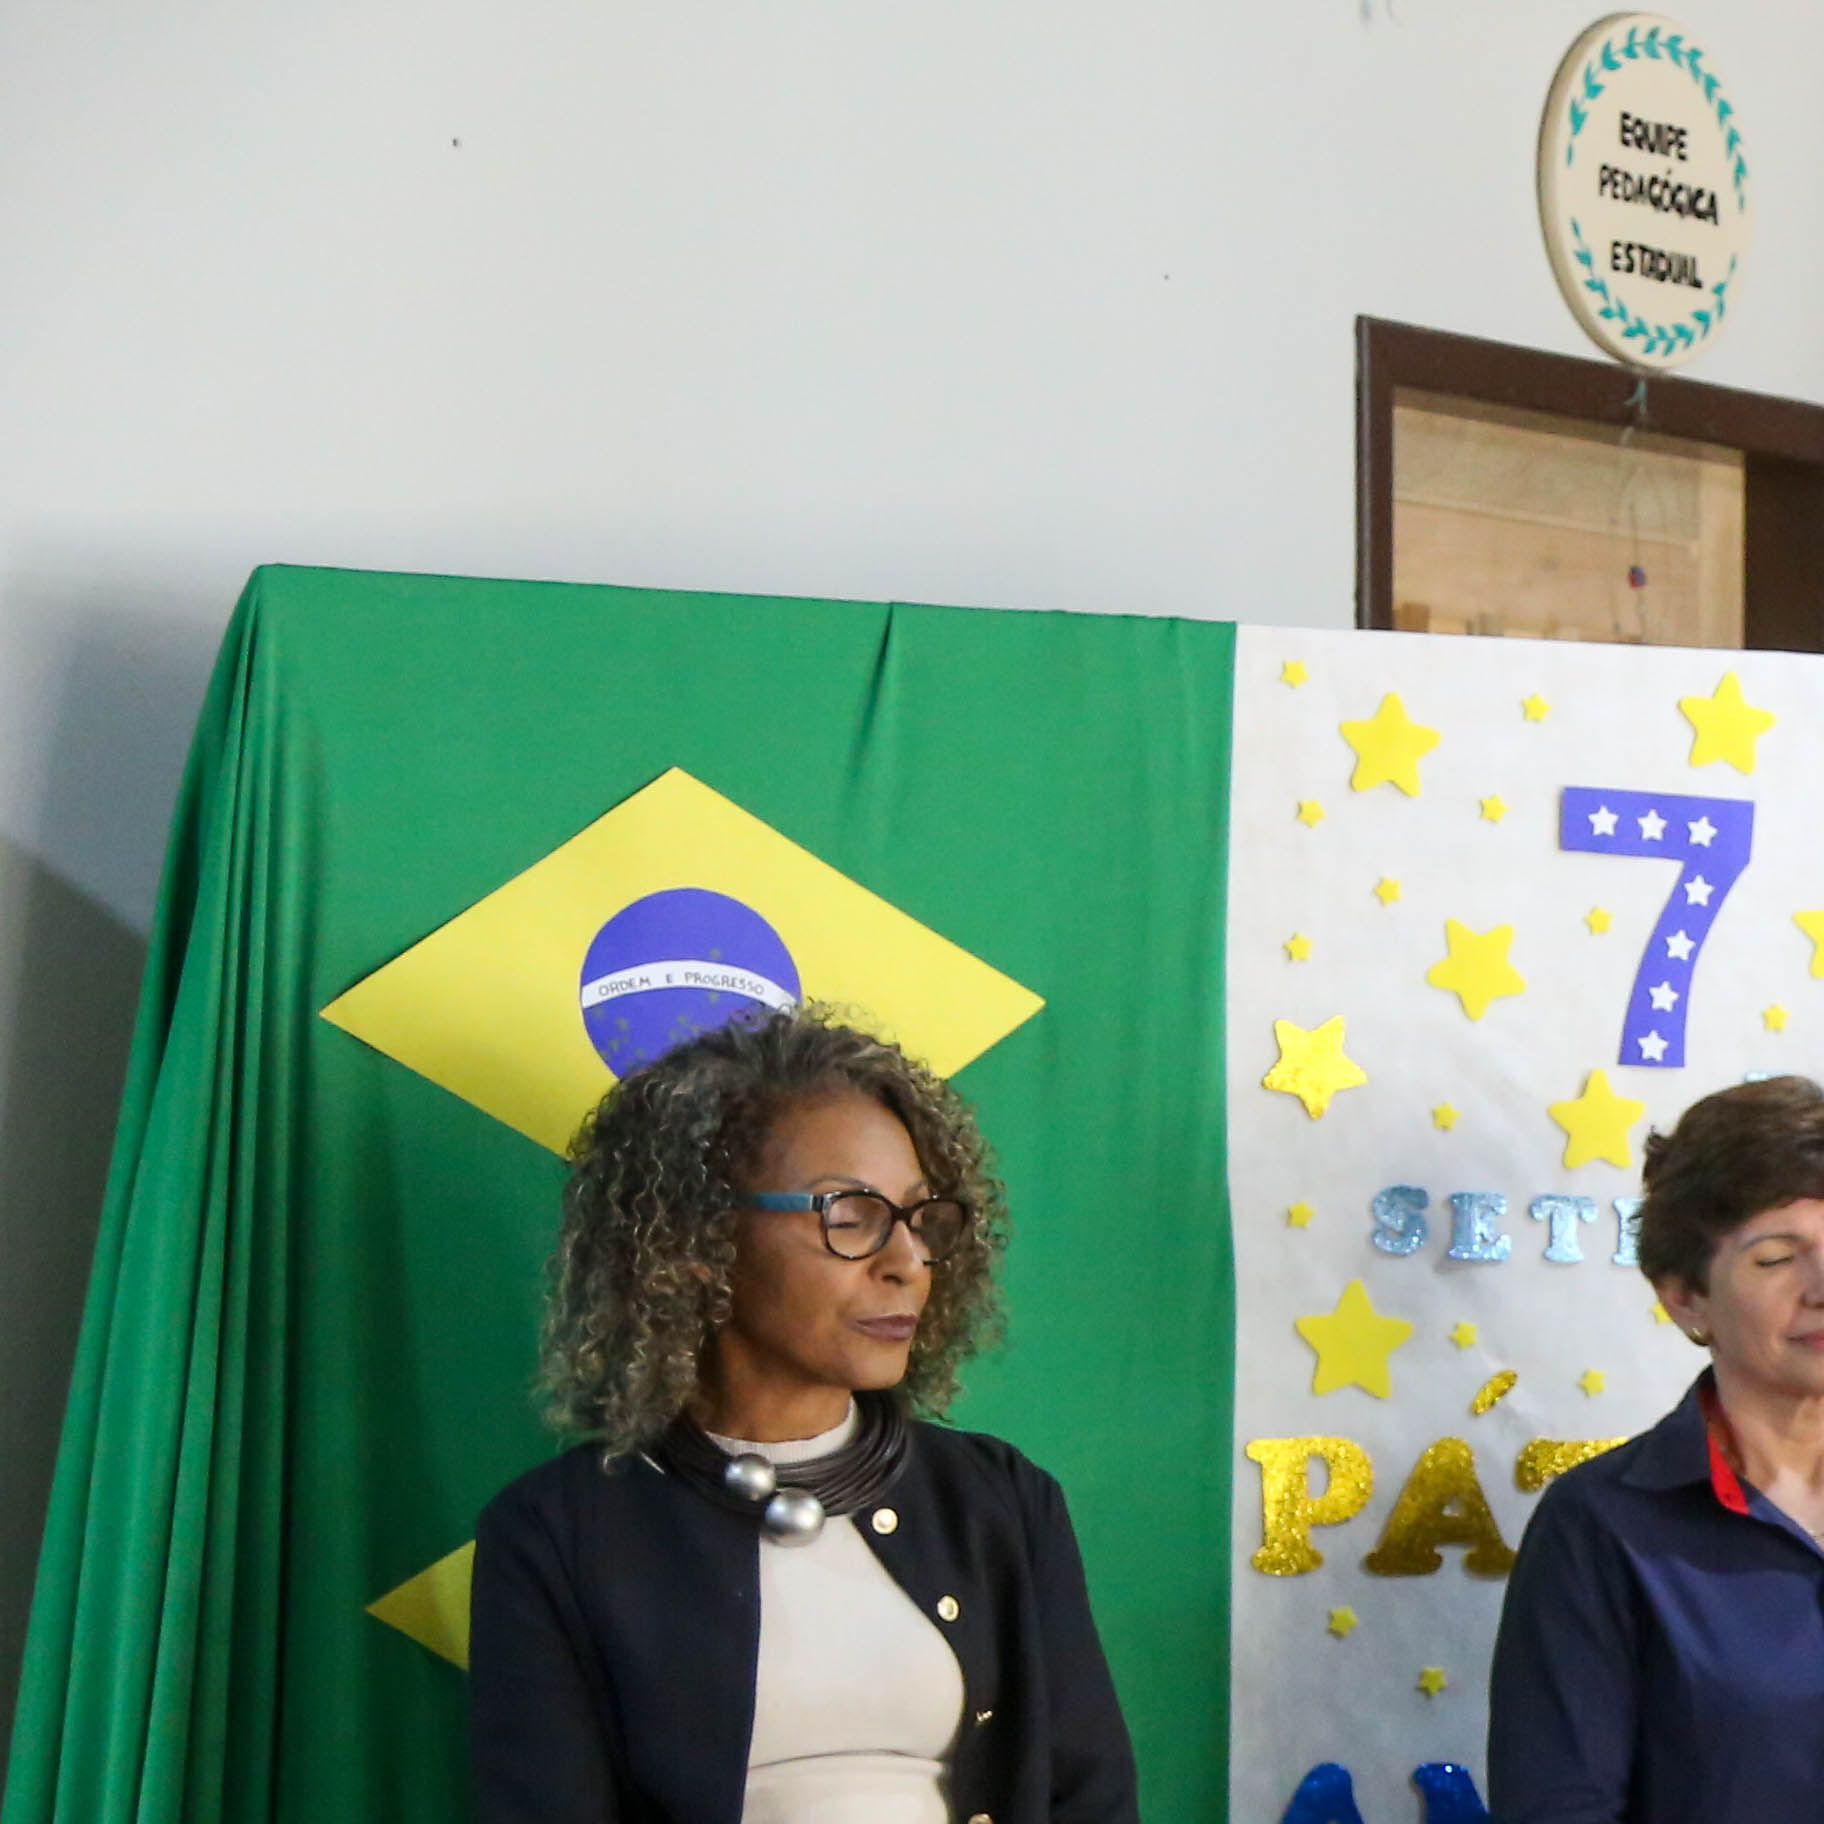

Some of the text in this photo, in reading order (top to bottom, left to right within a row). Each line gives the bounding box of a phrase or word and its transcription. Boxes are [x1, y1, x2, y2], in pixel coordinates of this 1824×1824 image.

[1619, 111, 1690, 163] EQUIPE
[1599, 163, 1720, 226] PEDAGÓGICA
[1610, 240, 1704, 290] ESTADUAL
[1560, 786, 1755, 1068] 7
[598, 970, 766, 998] ORDEM E PROGRESSO
